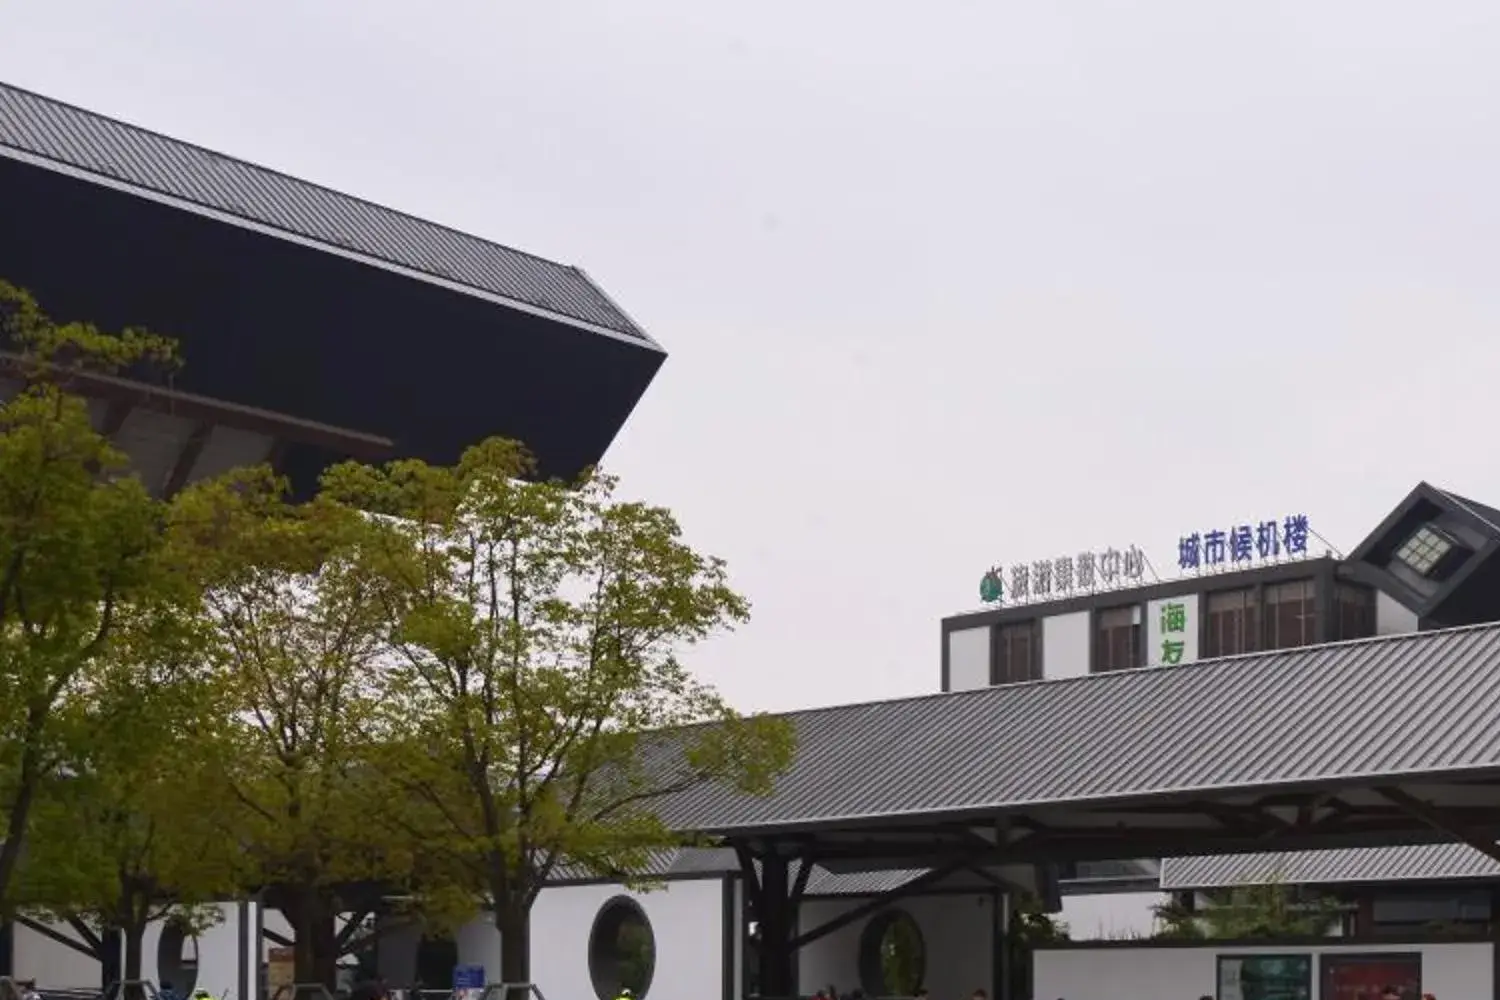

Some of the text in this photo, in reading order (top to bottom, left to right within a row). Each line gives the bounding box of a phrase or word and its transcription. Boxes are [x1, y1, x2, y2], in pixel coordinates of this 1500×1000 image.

[1178, 515, 1309, 568] 城市候机楼
[1161, 602, 1185, 664] 海友
